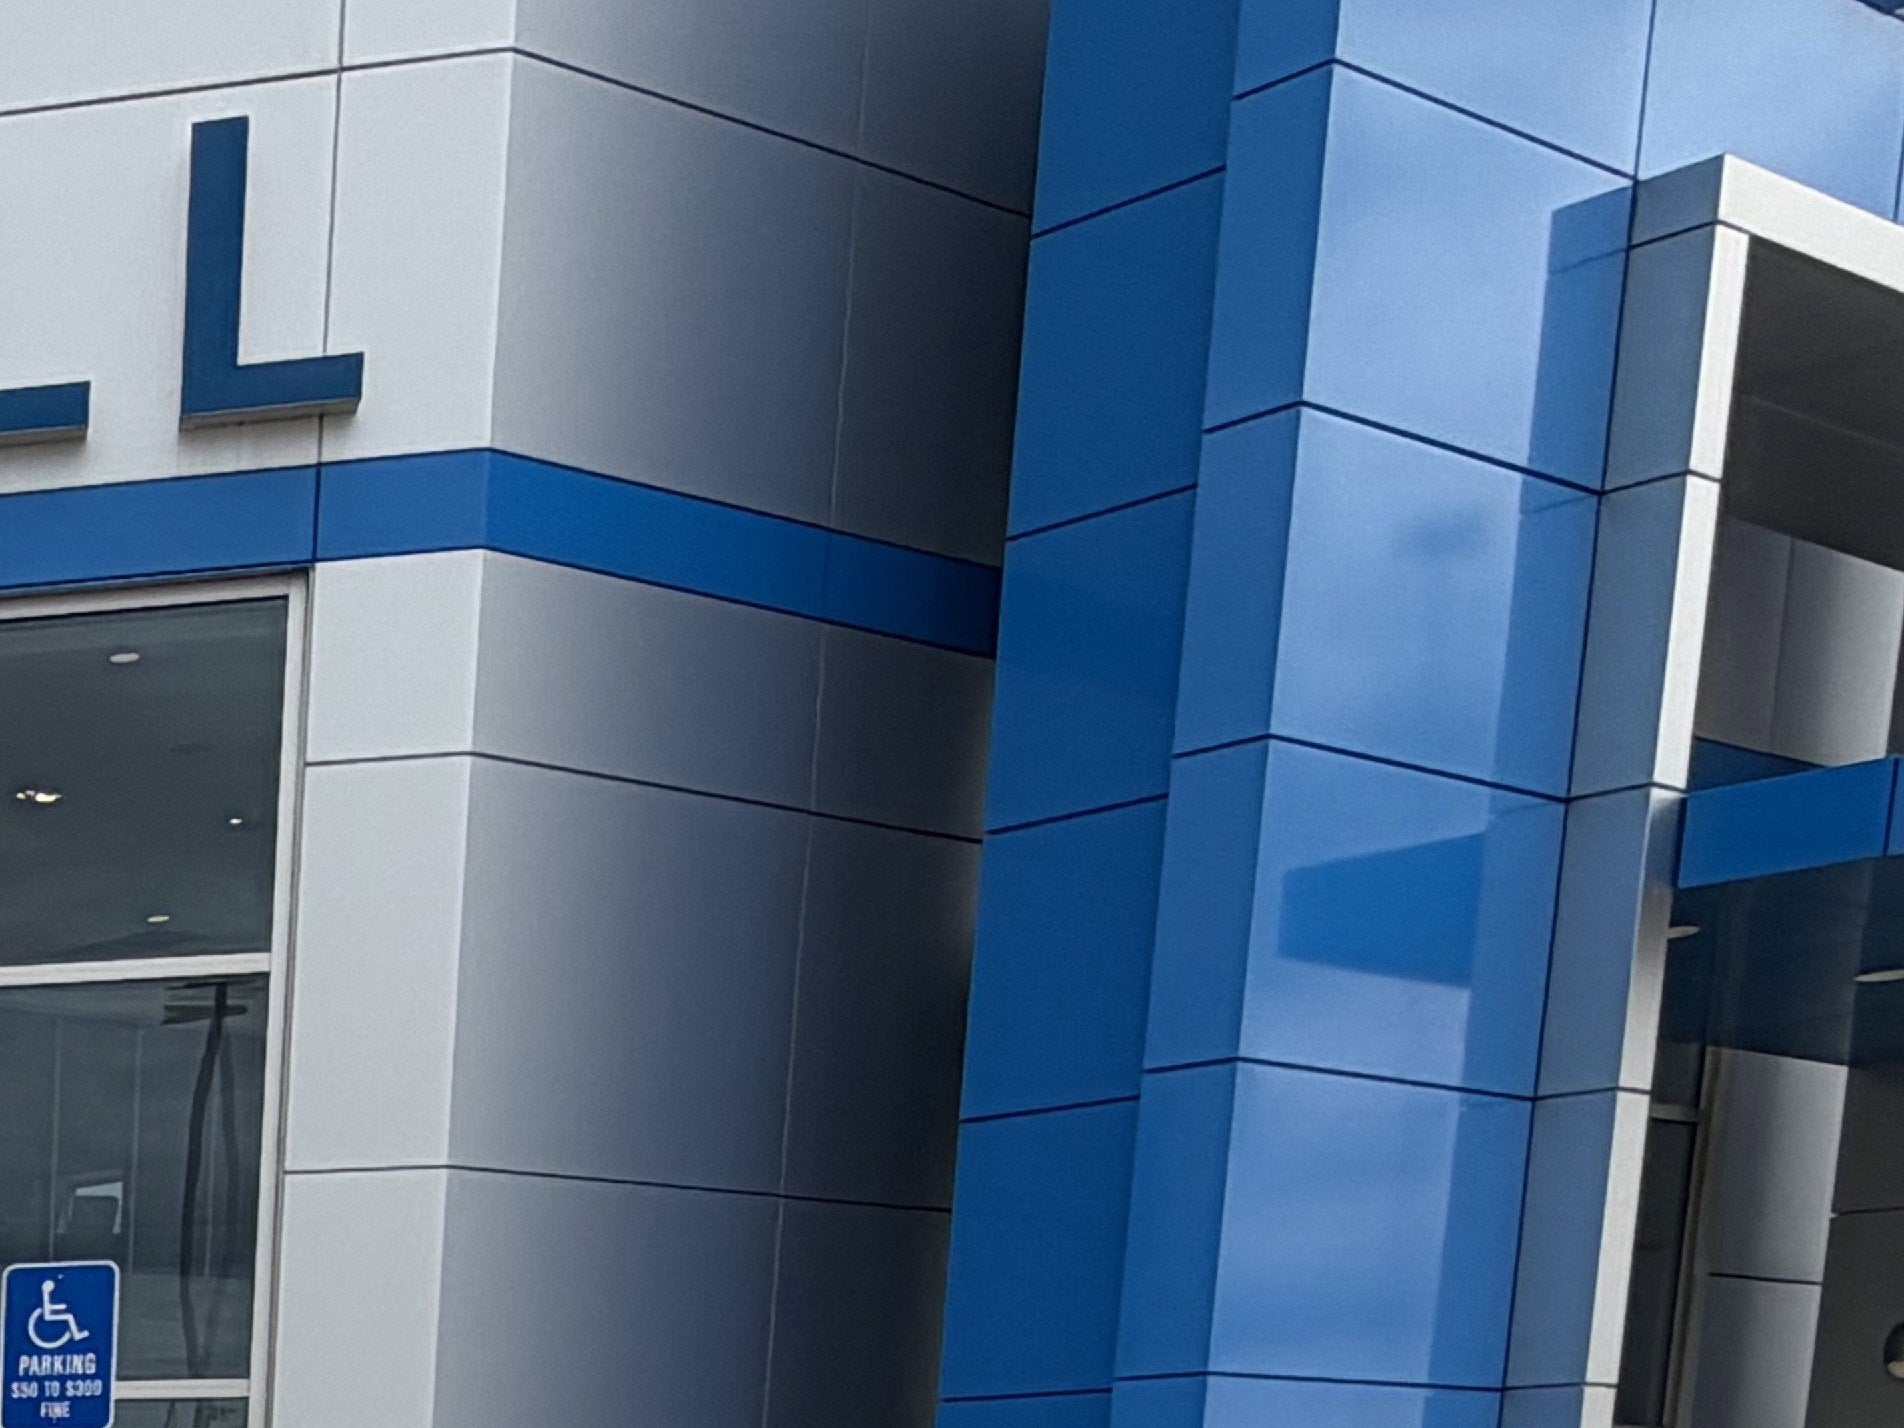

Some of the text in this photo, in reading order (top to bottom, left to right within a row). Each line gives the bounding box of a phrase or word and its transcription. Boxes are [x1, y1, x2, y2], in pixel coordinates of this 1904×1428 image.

[19, 1353, 96, 1376] PARKING
[11, 1379, 102, 1399] $50 TO $300
[40, 1402, 70, 1418] FINE
